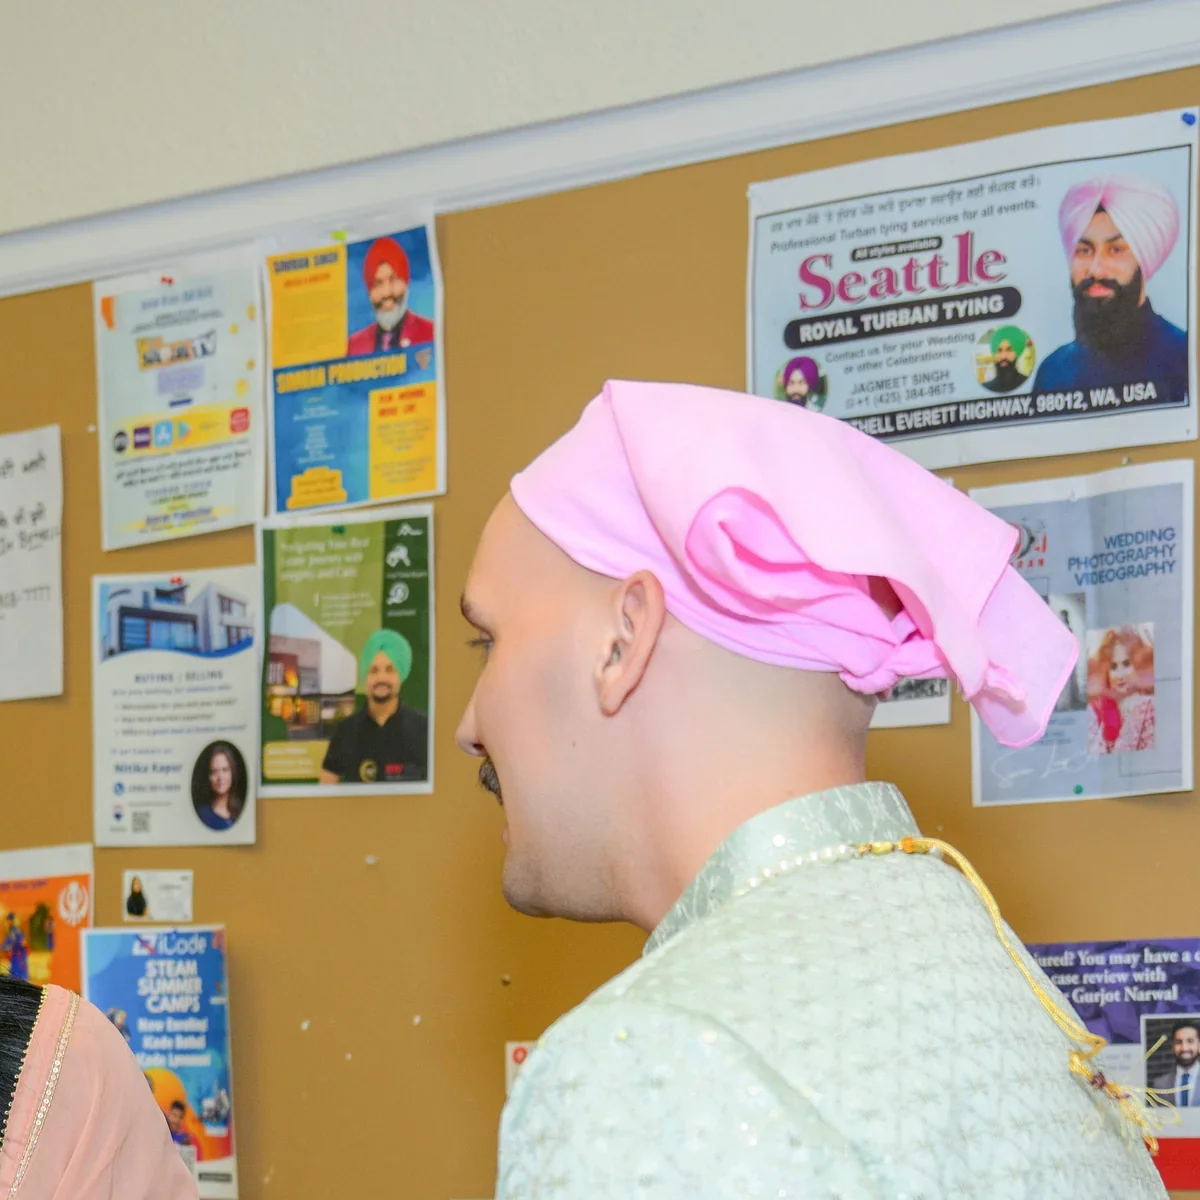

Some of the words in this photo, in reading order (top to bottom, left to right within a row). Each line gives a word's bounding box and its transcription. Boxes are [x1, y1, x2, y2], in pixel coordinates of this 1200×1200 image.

[770, 231, 837, 253] Professional
[840, 226, 876, 241] Turban
[880, 222, 908, 238] tying
[911, 214, 958, 229] services
[962, 209, 978, 220] for
[981, 205, 994, 217] all
[798, 229, 1007, 311] Seattle
[799, 319, 858, 343] ROYAL
[860, 304, 938, 333] TURBAN
[942, 294, 1004, 322] TYING
[825, 348, 865, 363] Contact
[867, 346, 880, 357] us
[882, 343, 898, 354] for
[900, 340, 924, 354] your
[926, 332, 976, 348] Wedding
[843, 365, 853, 375] or
[856, 360, 884, 374] other
[850, 375, 909, 396] JAGMEET
[911, 370, 950, 387] SINGH
[896, 404, 958, 431] EVERETT
[958, 394, 1034, 421] HIGHWAY,
[1036, 391, 1088, 412] 98012,
[1089, 387, 1121, 408] WA,
[1123, 381, 1157, 402] USA
[1104, 527, 1176, 549] WEDDING
[1067, 543, 1176, 571] PHOTOGRAPHY
[1074, 560, 1176, 587] VIDEOGRAPHY
[145, 959, 197, 978] STEAM
[1078, 950, 1105, 966] You
[1109, 952, 1141, 969] may
[1144, 947, 1178, 963] have
[1181, 952, 1190, 963] a
[137, 977, 203, 996] SUMMER
[1050, 974, 1079, 986] case
[1083, 970, 1129, 985] review
[1133, 966, 1167, 983] with
[146, 995, 200, 1013] CAMPS
[1071, 986, 1120, 1007] Gurjot
[1124, 984, 1178, 1002] Narwal
